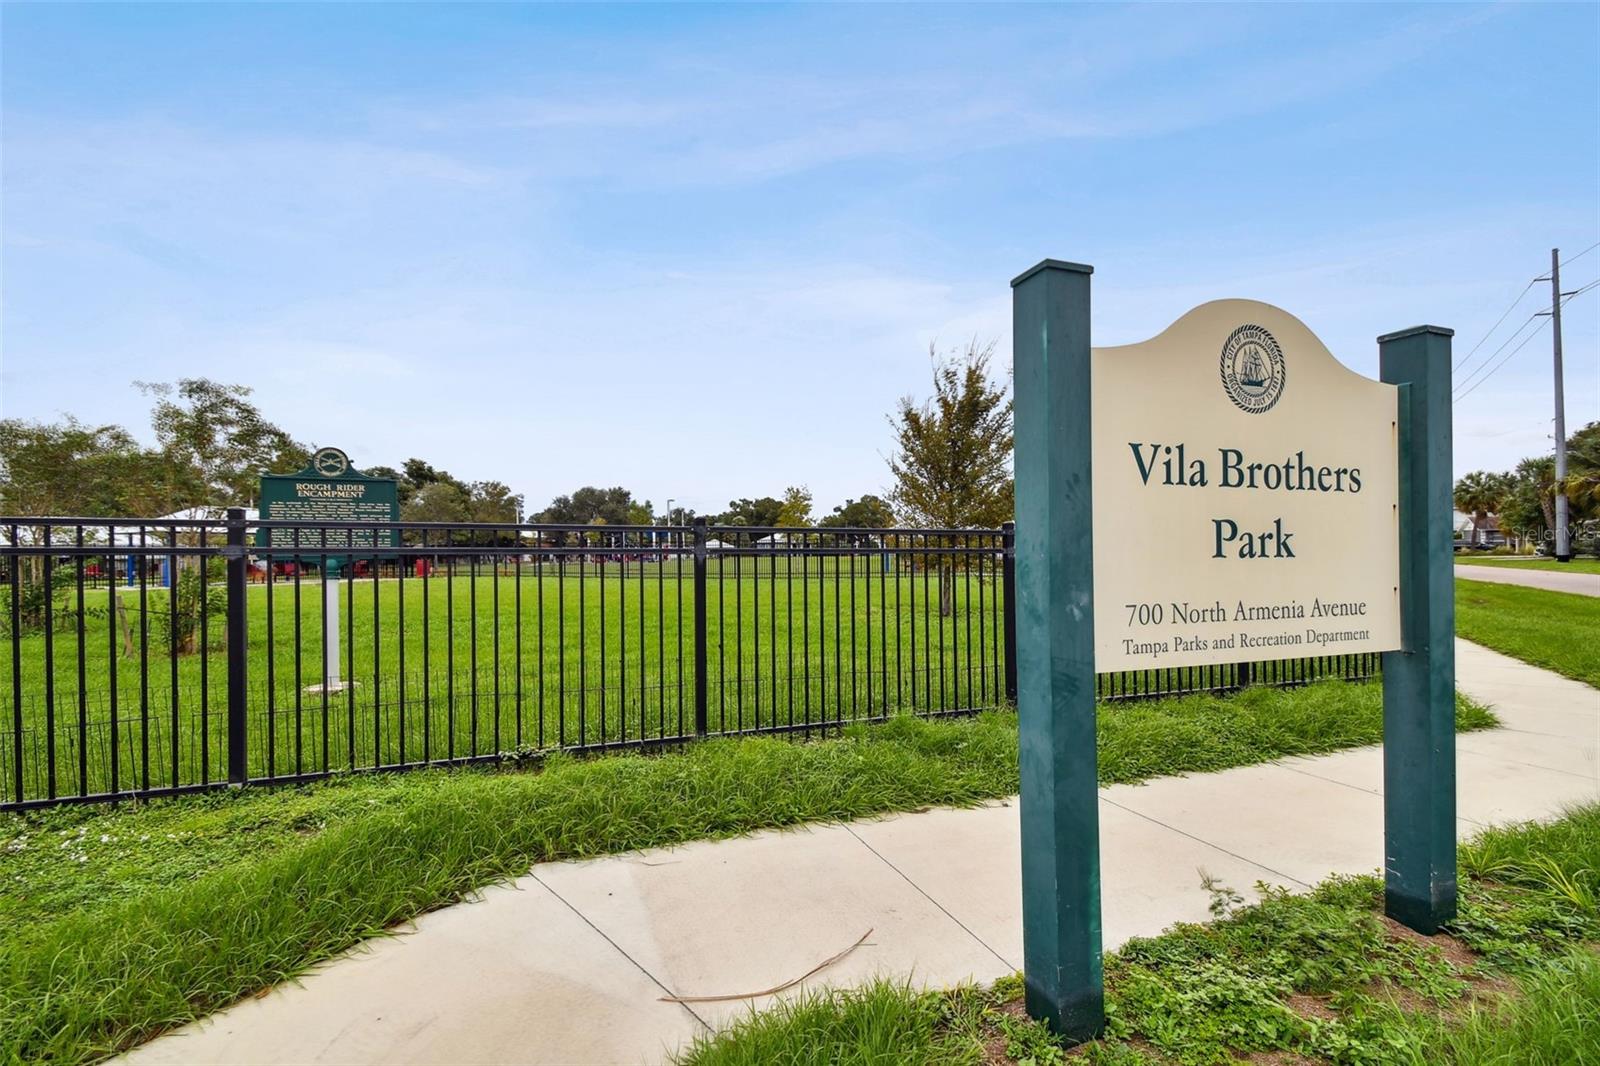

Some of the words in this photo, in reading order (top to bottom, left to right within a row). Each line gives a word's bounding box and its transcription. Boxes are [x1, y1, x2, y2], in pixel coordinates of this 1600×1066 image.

[1226, 344, 1237, 361] CITY
[1242, 331, 1262, 341] TAMPA
[1262, 336, 1280, 366] FLORIDA
[1128, 442, 1208, 487] Vila
[1218, 447, 1362, 493] Brothers
[296, 483, 331, 491] ROUGH
[336, 484, 365, 492] RIDER
[1211, 518, 1296, 559] Park
[1125, 603, 1163, 627] 700
[1172, 601, 1226, 624] North
[1233, 600, 1305, 622] Armenia
[1310, 597, 1367, 618] Avenue
[1122, 638, 1169, 658] Tampa
[1173, 636, 1208, 652] Parks
[1212, 633, 1235, 650] and
[1239, 630, 1303, 648] Recreation
[1306, 628, 1370, 646] Department
